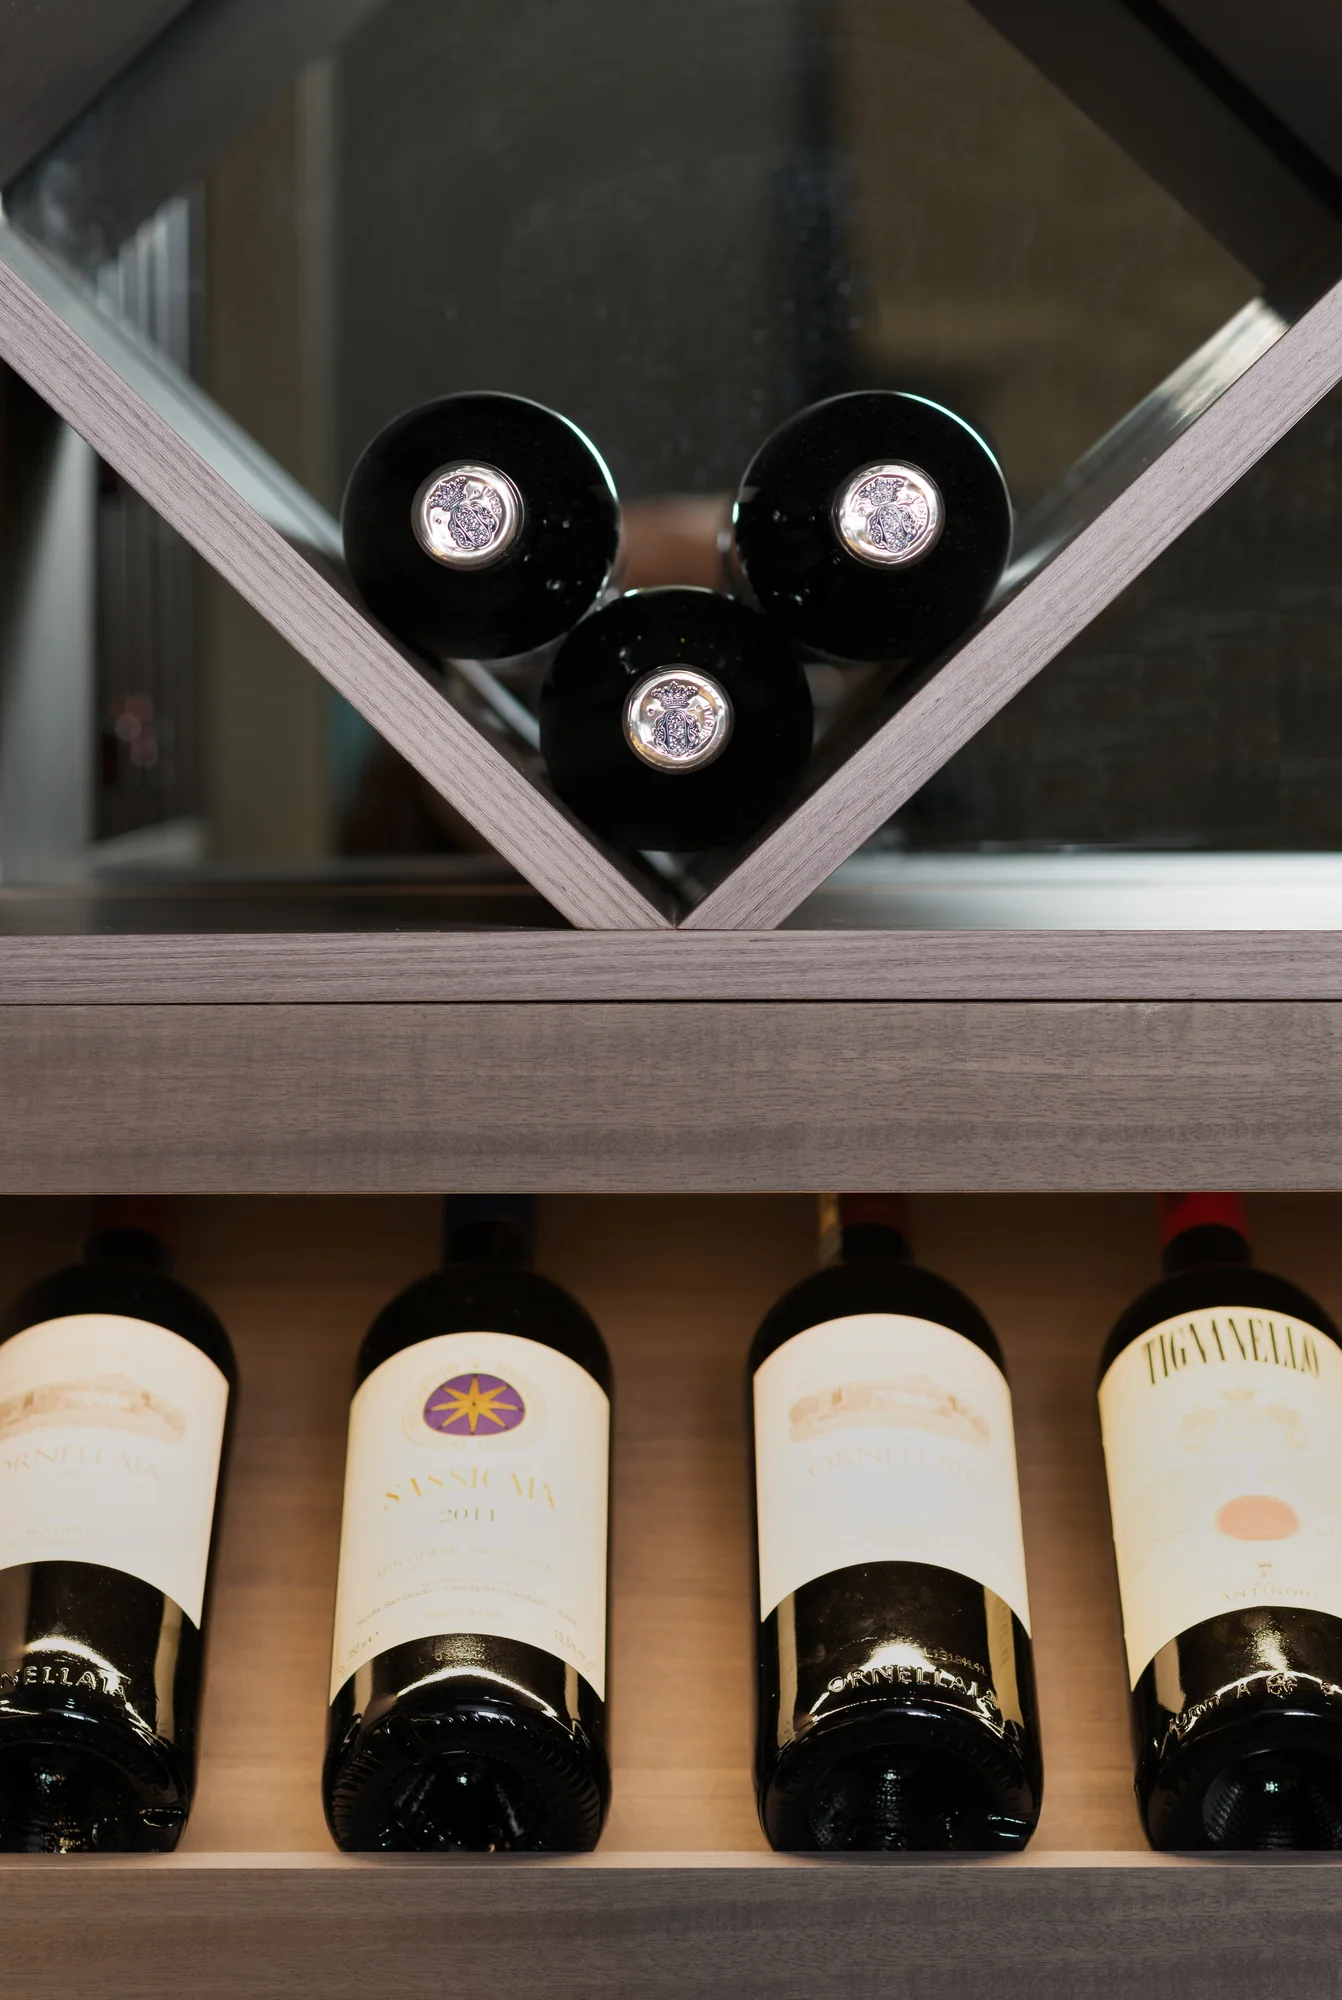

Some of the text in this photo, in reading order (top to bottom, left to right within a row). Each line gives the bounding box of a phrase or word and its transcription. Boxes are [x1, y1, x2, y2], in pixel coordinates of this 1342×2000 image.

[1143, 1318, 1320, 1386] TIGNANELLO
[383, 1467, 557, 1511] SASSICAIA
[438, 1506, 497, 1524] 2011
